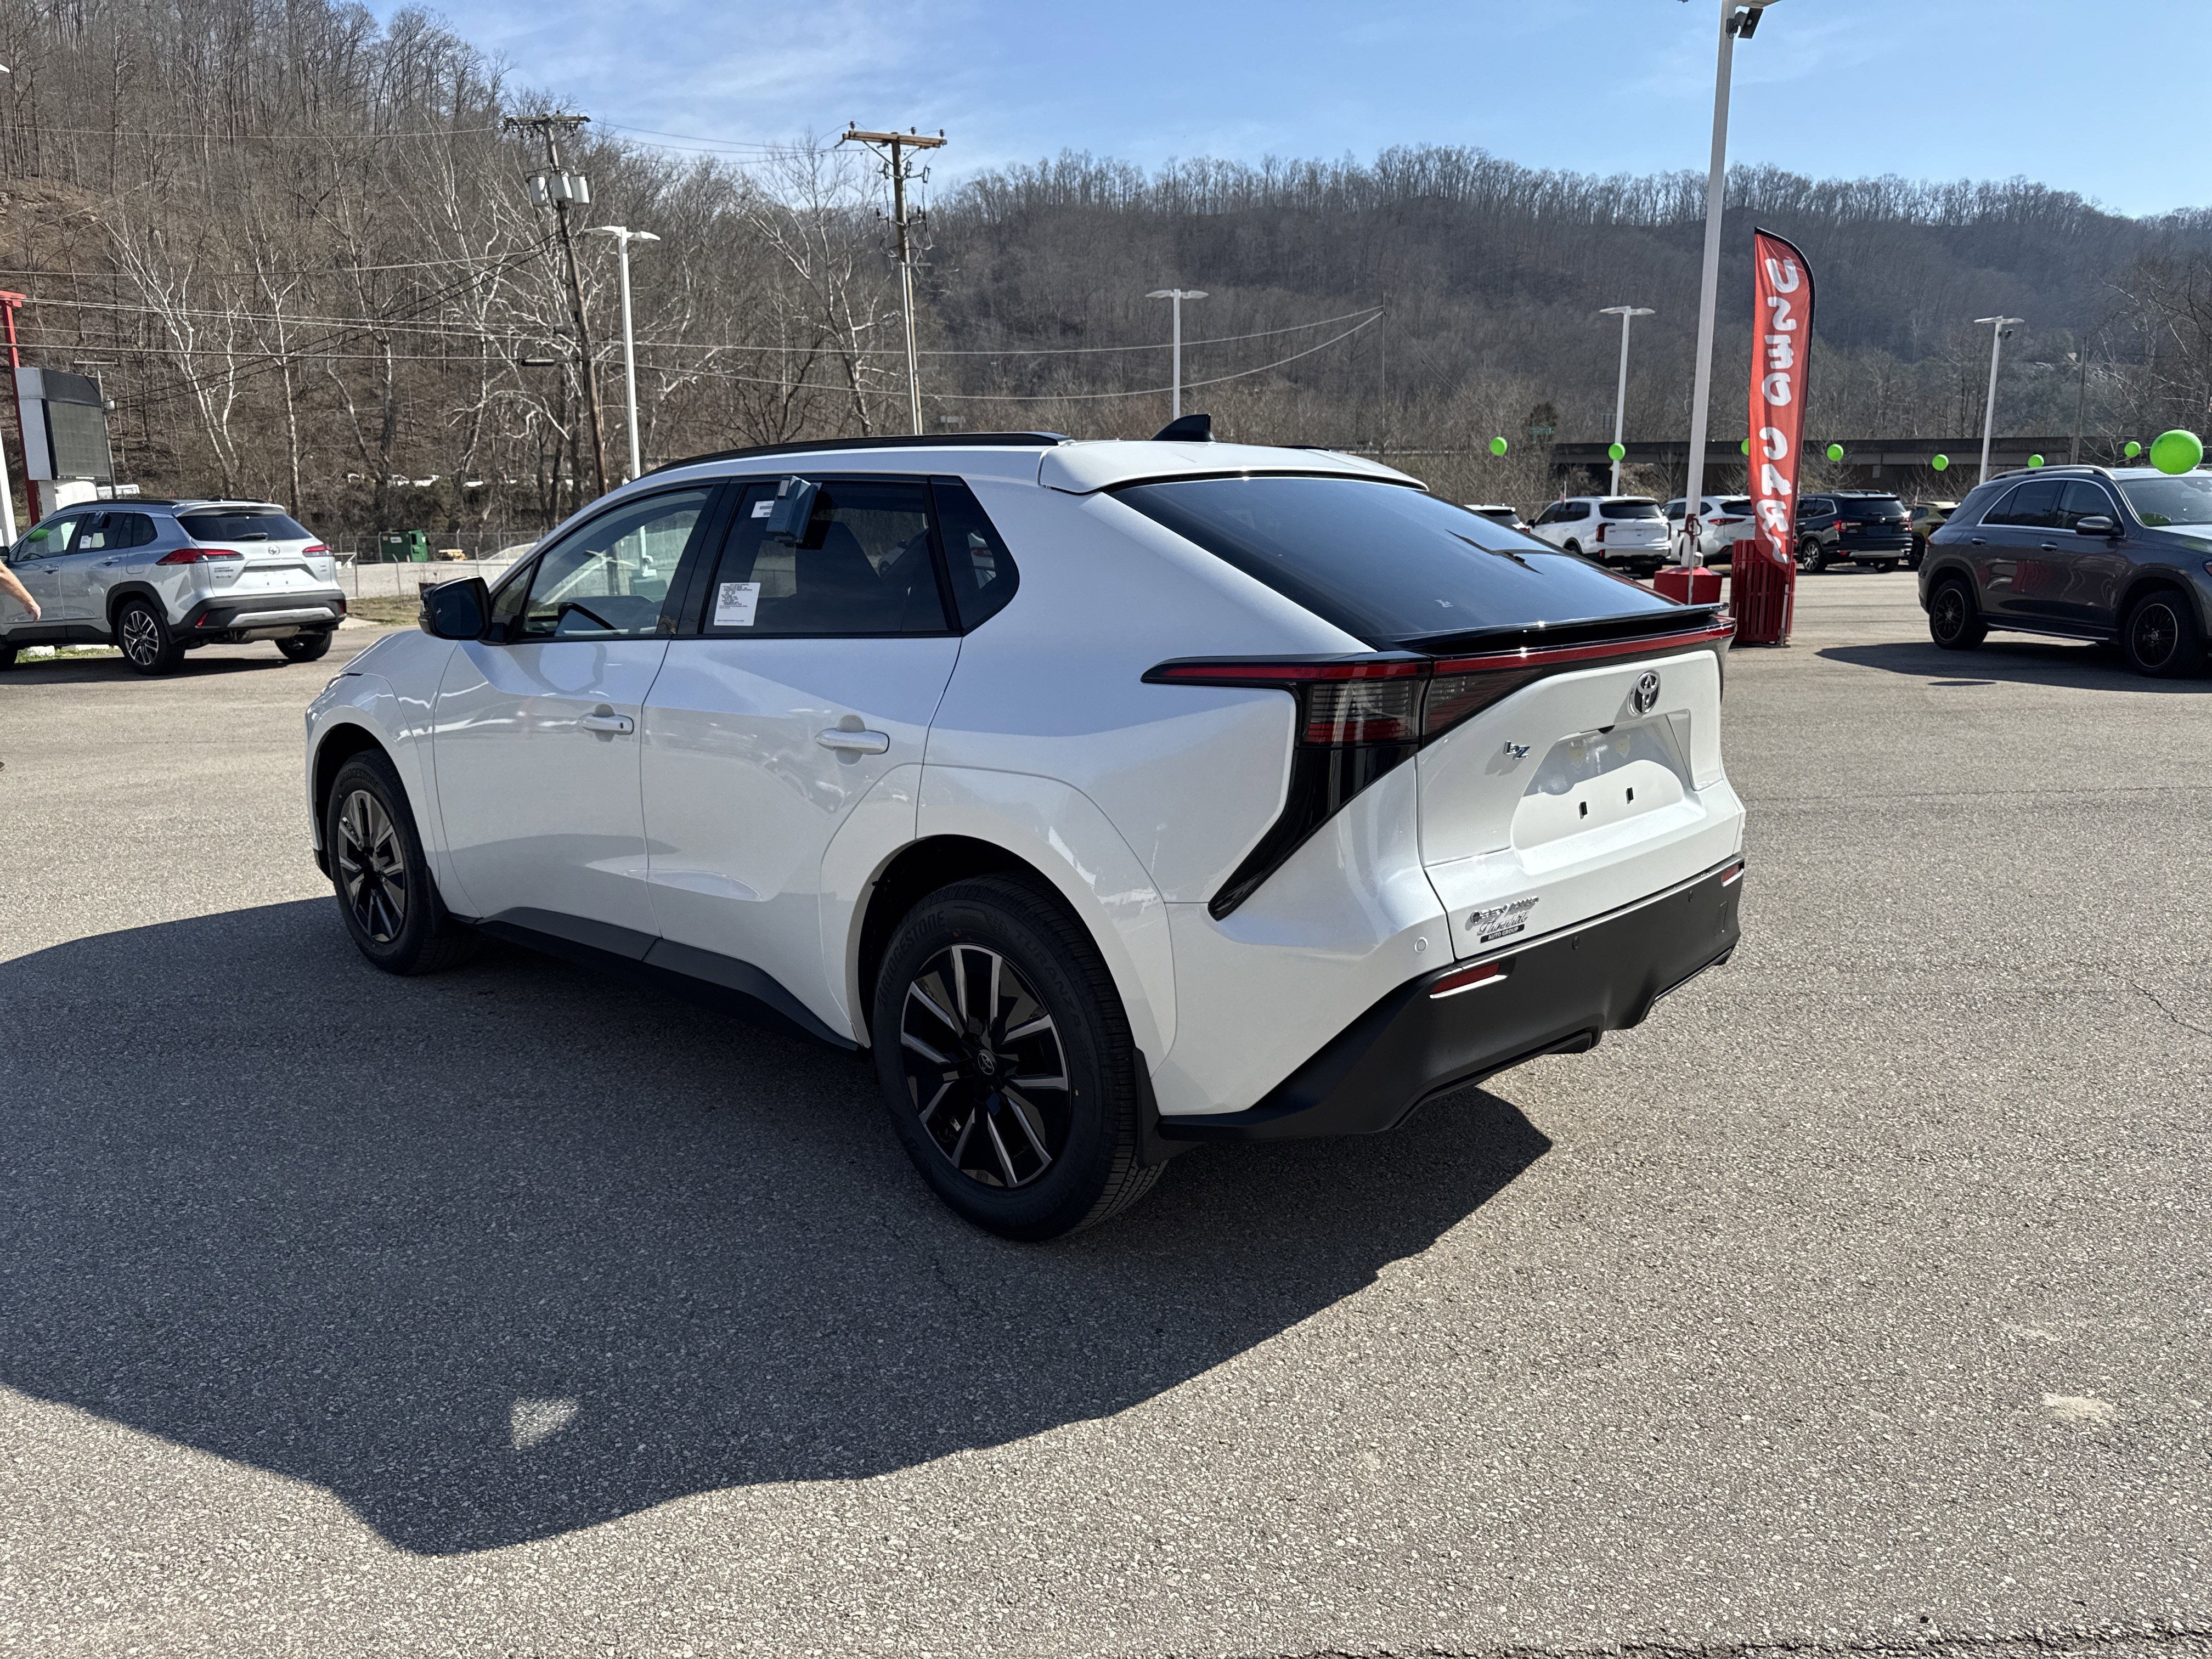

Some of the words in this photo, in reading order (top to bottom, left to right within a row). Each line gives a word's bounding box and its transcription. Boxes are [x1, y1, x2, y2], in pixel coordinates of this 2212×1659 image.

[1488, 932, 1501, 940] AUTO
[1502, 927, 1519, 936] GROUP
[1014, 929, 1082, 1027] TURANZA
